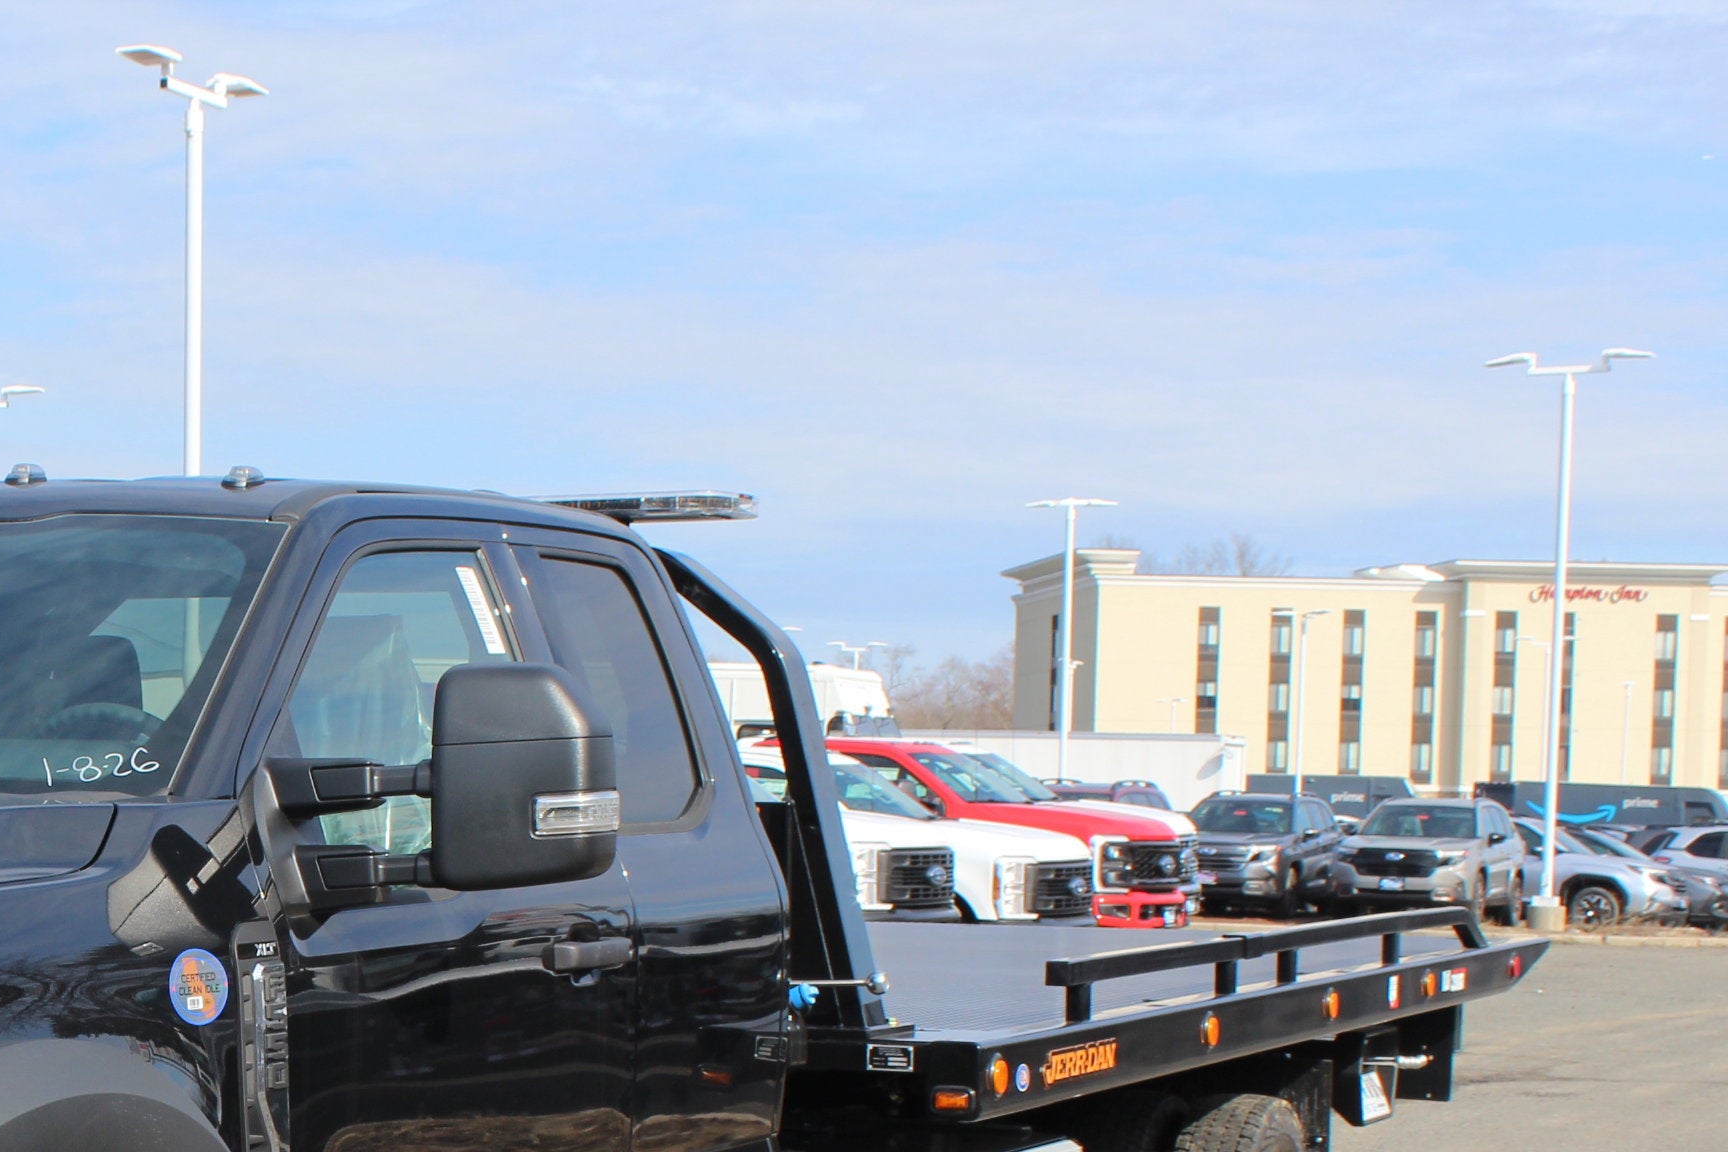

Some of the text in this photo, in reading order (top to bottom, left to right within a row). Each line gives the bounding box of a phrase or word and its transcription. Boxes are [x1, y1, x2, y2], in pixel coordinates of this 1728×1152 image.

[1329, 790, 1366, 804] prime
[1622, 796, 1660, 810] prime
[254, 942, 277, 957] XLT
[180, 972, 216, 984] CERTIFIED
[178, 983, 221, 997] CLEAN DLE
[1042, 1039, 1118, 1086] JERR-DAN
